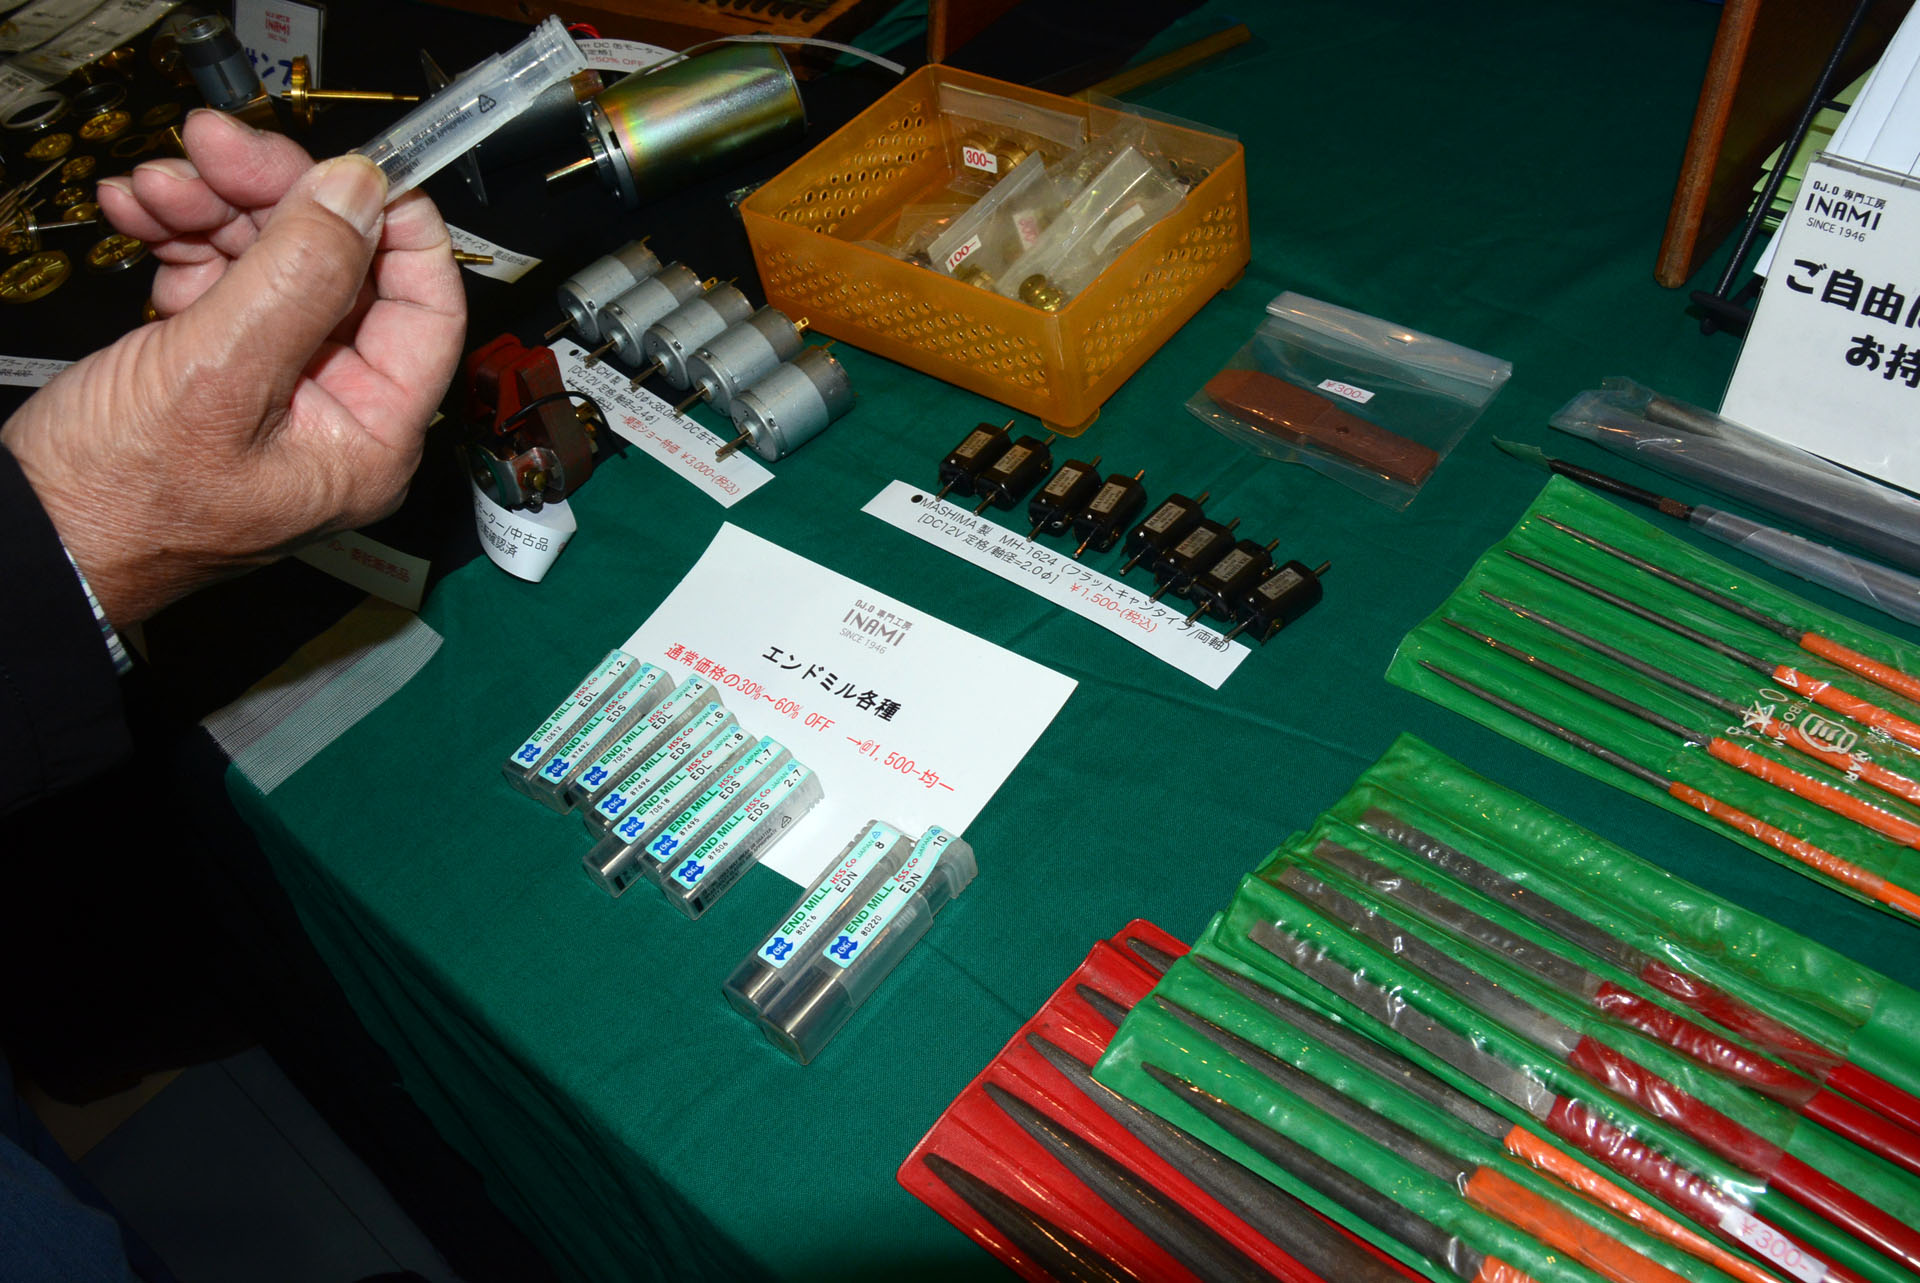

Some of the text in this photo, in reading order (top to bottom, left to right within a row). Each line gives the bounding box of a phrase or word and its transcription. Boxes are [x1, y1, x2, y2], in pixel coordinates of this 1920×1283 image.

[1805, 193, 1883, 231] INAMI
[1843, 189, 1887, 210] 専門工房
[1806, 217, 1866, 242] SINCE 1946
[682, 421, 700, 434] DC
[696, 431, 738, 459] 缶モーー
[917, 512, 964, 538] [DC12V
[919, 497, 977, 529] MASHIMA
[976, 523, 994, 537] 製
[999, 534, 1059, 566] MH-1624
[842, 608, 906, 647] INAMI
[876, 608, 913, 631] 専門工房
[839, 627, 888, 655] SINCE 1946
[544, 661, 625, 743] 70512 EDL 1.2
[607, 704, 626, 723] EDS
[639, 674, 655, 688] 1.3
[761, 646, 902, 722] エンドミル各種
[531, 722, 553, 742] END
[551, 701, 576, 722] MILL
[560, 737, 580, 757] END
[579, 716, 605, 736] MILL
[613, 684, 703, 764] 70514 EDL 1.4
[803, 711, 836, 732] OFF
[600, 745, 622, 765] END
[622, 725, 648, 745] MILL
[630, 712, 723, 796] 87494 EDS 1.6
[690, 765, 712, 780] EDL
[725, 733, 743, 749] 1.8
[618, 772, 641, 792] END
[641, 752, 667, 772] MILL
[719, 781, 740, 800] EDS
[755, 749, 771, 765] 1.7
[637, 795, 659, 815] END
[660, 774, 687, 795] MILL
[668, 812, 692, 832] END
[691, 790, 718, 812] MILL
[708, 769, 800, 859] 87506 EDS 2.7
[694, 837, 718, 859] END
[717, 815, 744, 837] MILL
[795, 841, 885, 935] 80216 EDN 8
[860, 835, 948, 937] 80220 EDN 10
[782, 912, 807, 935] END
[804, 885, 832, 915] MILL
[844, 911, 869, 935] END
[867, 884, 895, 914] MILL
